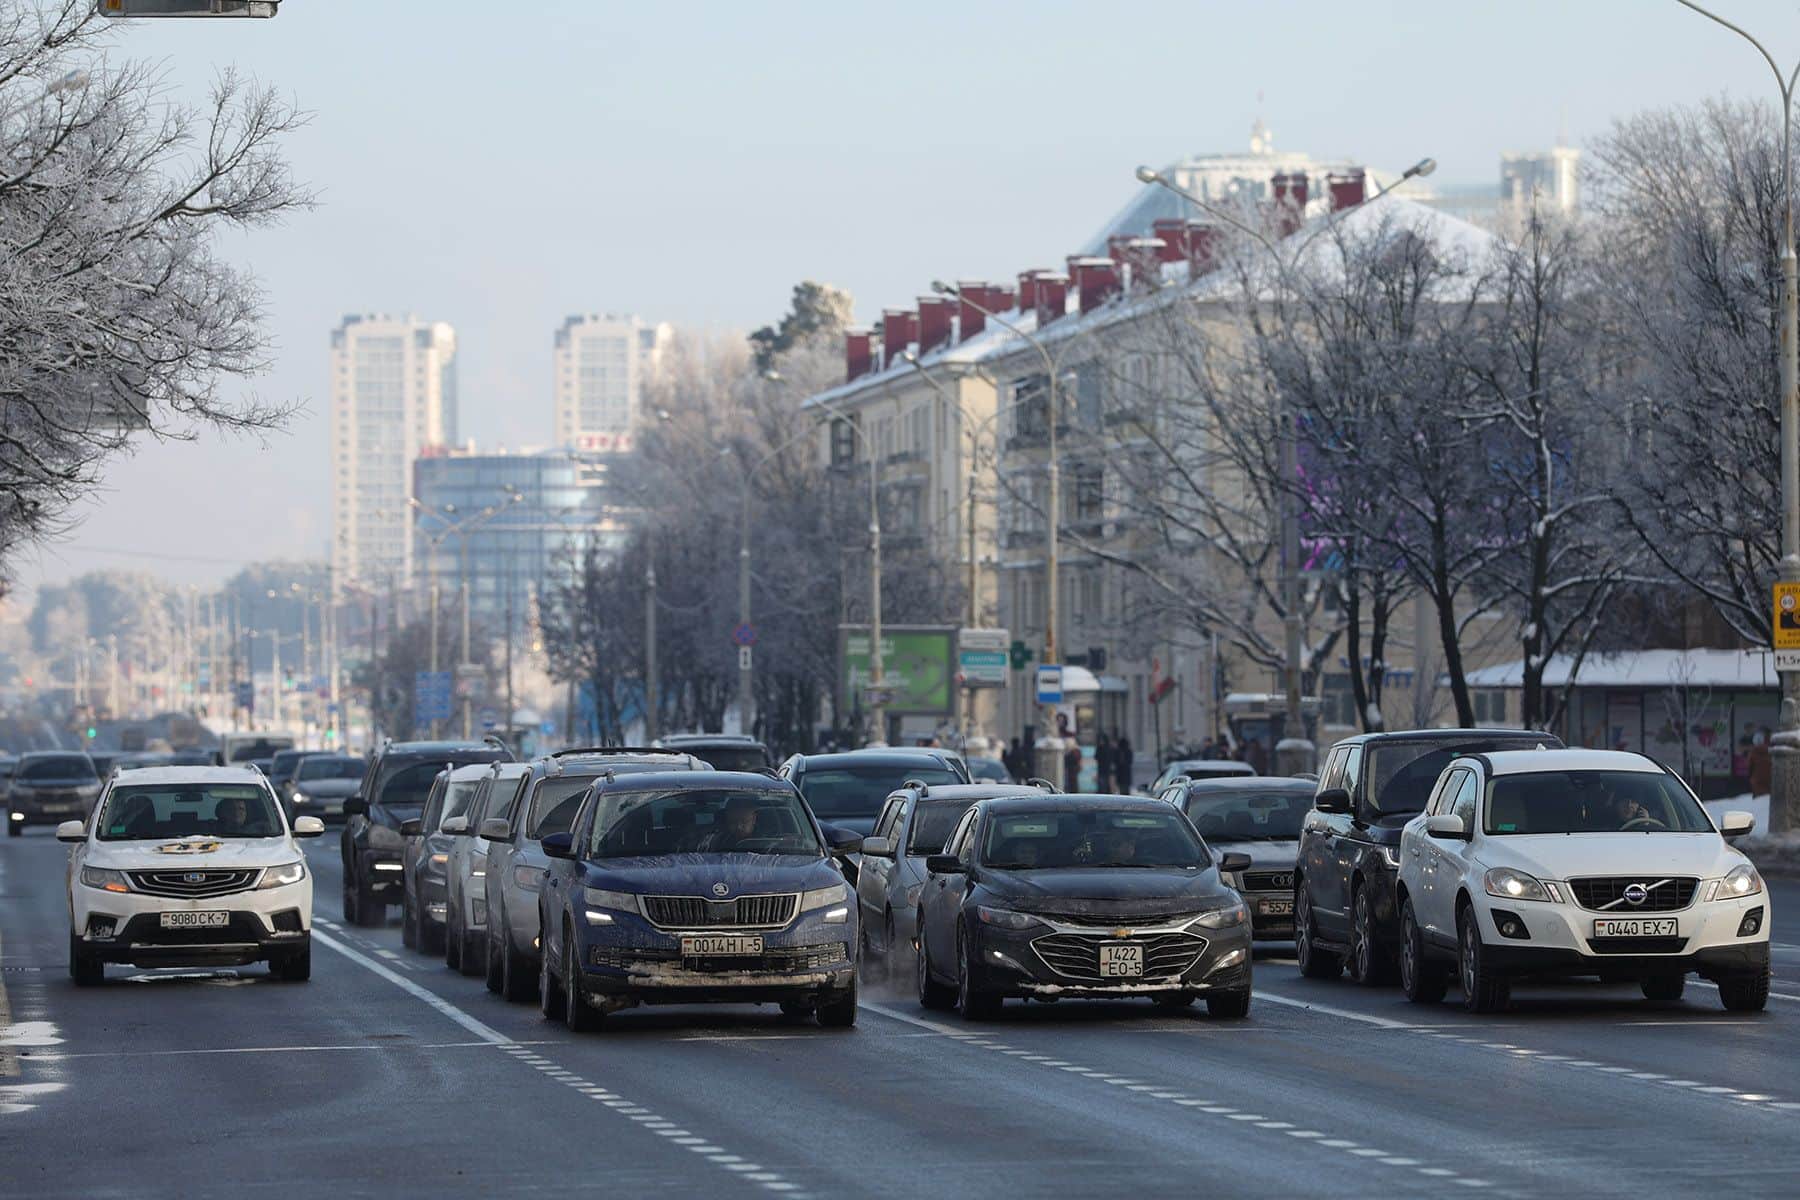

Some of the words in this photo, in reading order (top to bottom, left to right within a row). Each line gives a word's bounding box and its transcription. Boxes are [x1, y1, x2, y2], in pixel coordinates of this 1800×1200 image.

[1607, 922, 1639, 935] 0440
[1643, 921, 1675, 935] EX-7
[1108, 947, 1137, 961] 1422
